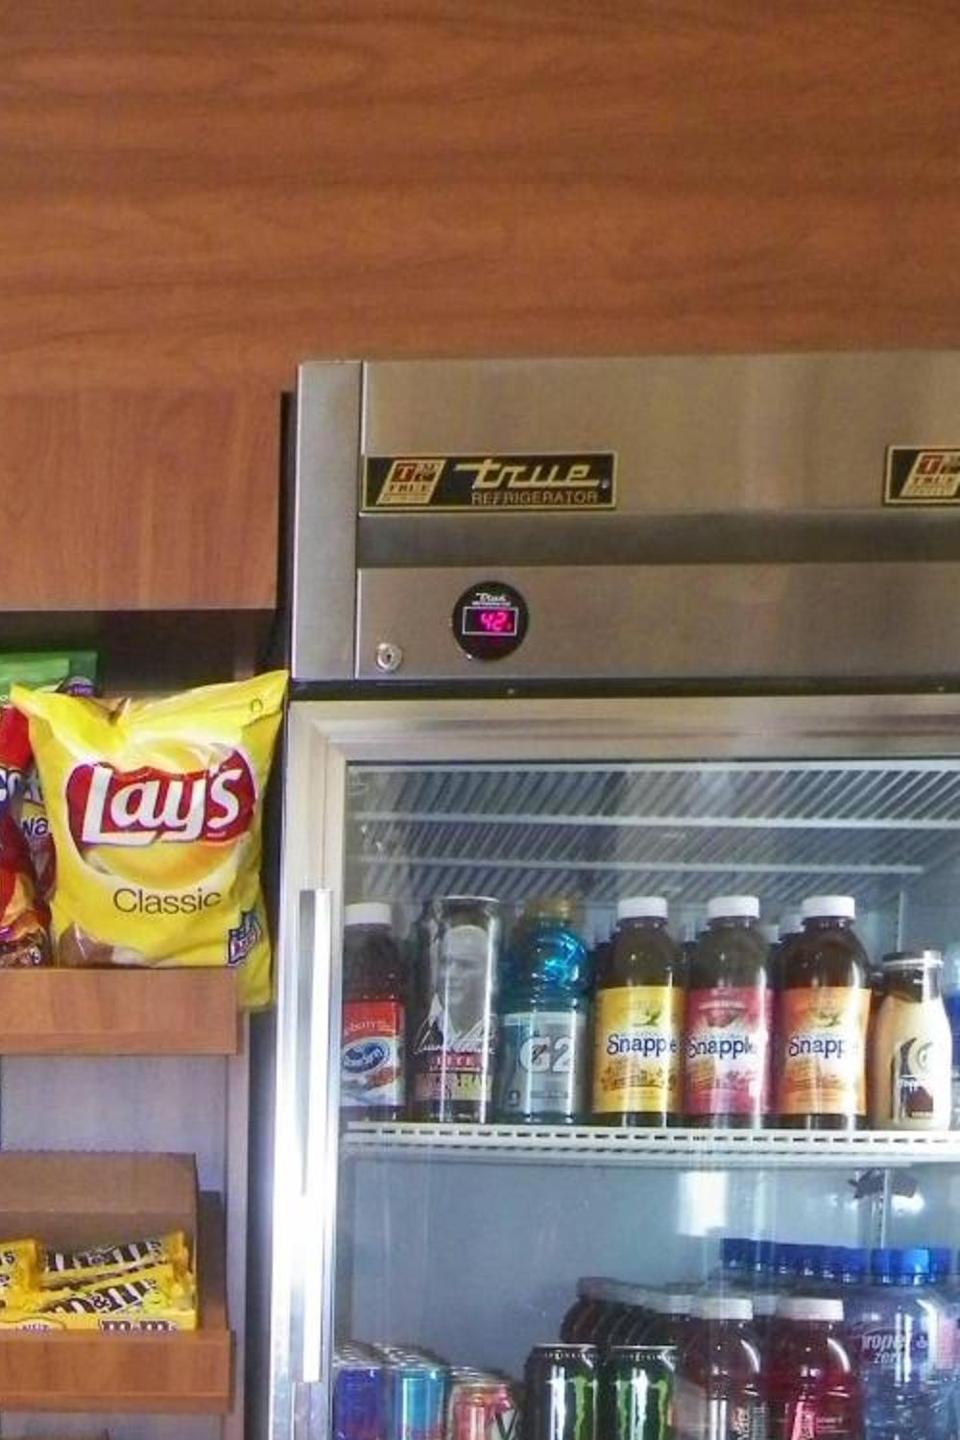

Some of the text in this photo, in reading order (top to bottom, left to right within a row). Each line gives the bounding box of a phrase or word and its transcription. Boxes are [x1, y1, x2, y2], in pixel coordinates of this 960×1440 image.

[471, 491, 599, 506] REFRIGERATOR
[481, 612, 507, 631] 42
[83, 764, 244, 848] Lay's
[113, 888, 222, 916] Classic
[606, 1034, 678, 1060] Snappe
[689, 1035, 755, 1060] Snappl
